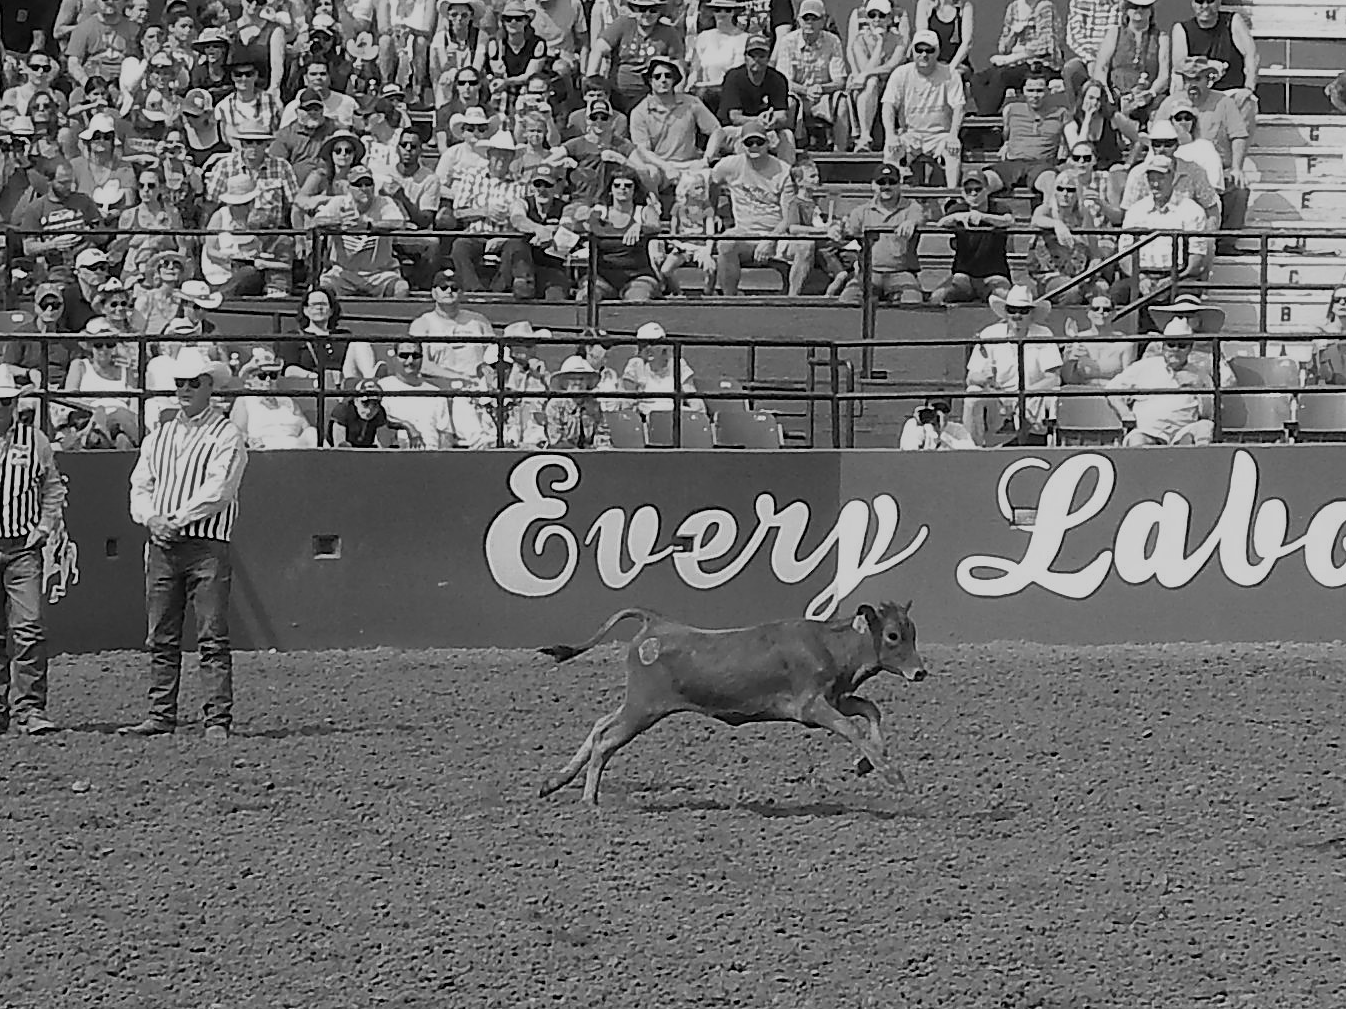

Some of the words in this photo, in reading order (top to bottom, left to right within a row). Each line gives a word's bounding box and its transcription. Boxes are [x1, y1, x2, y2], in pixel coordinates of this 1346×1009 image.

[1310, 126, 1320, 141] G
[1307, 157, 1318, 174] F
[1301, 191, 1311, 209] E
[1289, 270, 1299, 285] C
[1281, 306, 1291, 322] B
[485, 453, 930, 622] Every
